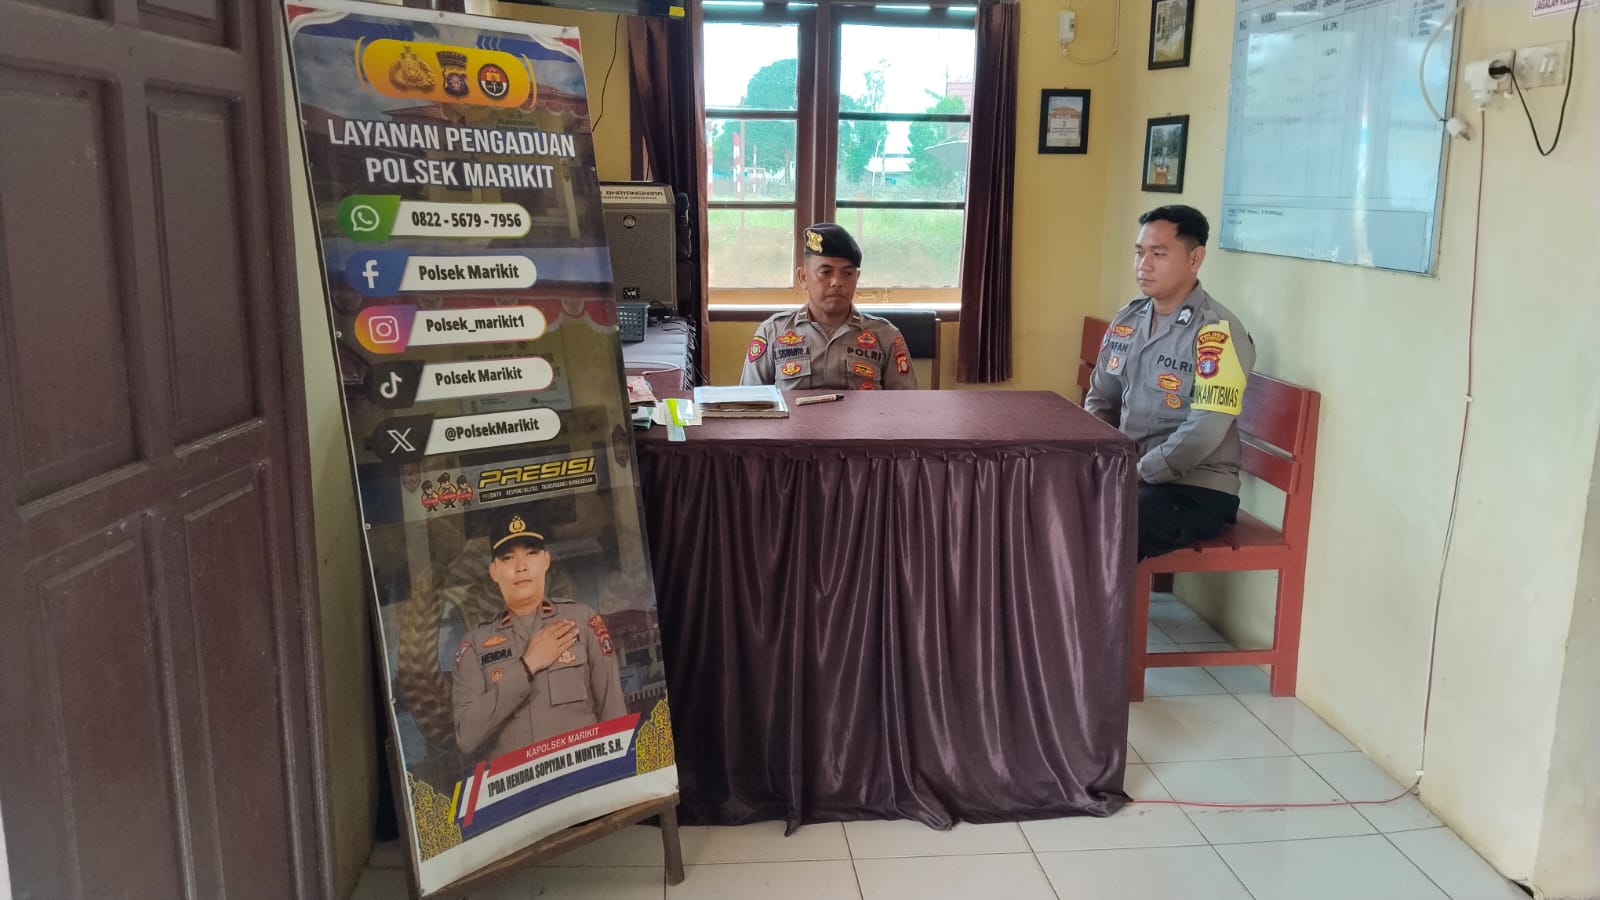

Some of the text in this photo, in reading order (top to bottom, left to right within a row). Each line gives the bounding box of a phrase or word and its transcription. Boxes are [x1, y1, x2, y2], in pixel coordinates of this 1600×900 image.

[328, 118, 576, 157] LAYANAN PENGADUAN
[365, 157, 554, 189] POLSEK MARIKIT
[411, 211, 441, 228] 0822
[451, 212, 482, 228] 5679
[490, 212, 522, 229] 7956
[418, 263, 520, 281] Polsek Marikit
[425, 315, 525, 333] Polsek_marikit1
[847, 347, 882, 362] POLRI
[1156, 354, 1193, 373] POLRI
[434, 366, 523, 386] Polsek Marikit
[444, 419, 540, 442] @PolsekMarikit
[478, 456, 597, 489] PRESISI
[480, 648, 513, 666] HENDRA
[526, 726, 600, 758] KAPOLSEK MARIKIT
[487, 738, 624, 798] IPDA HENDRA SOPIYAN D. MUNTHE, S.H.
